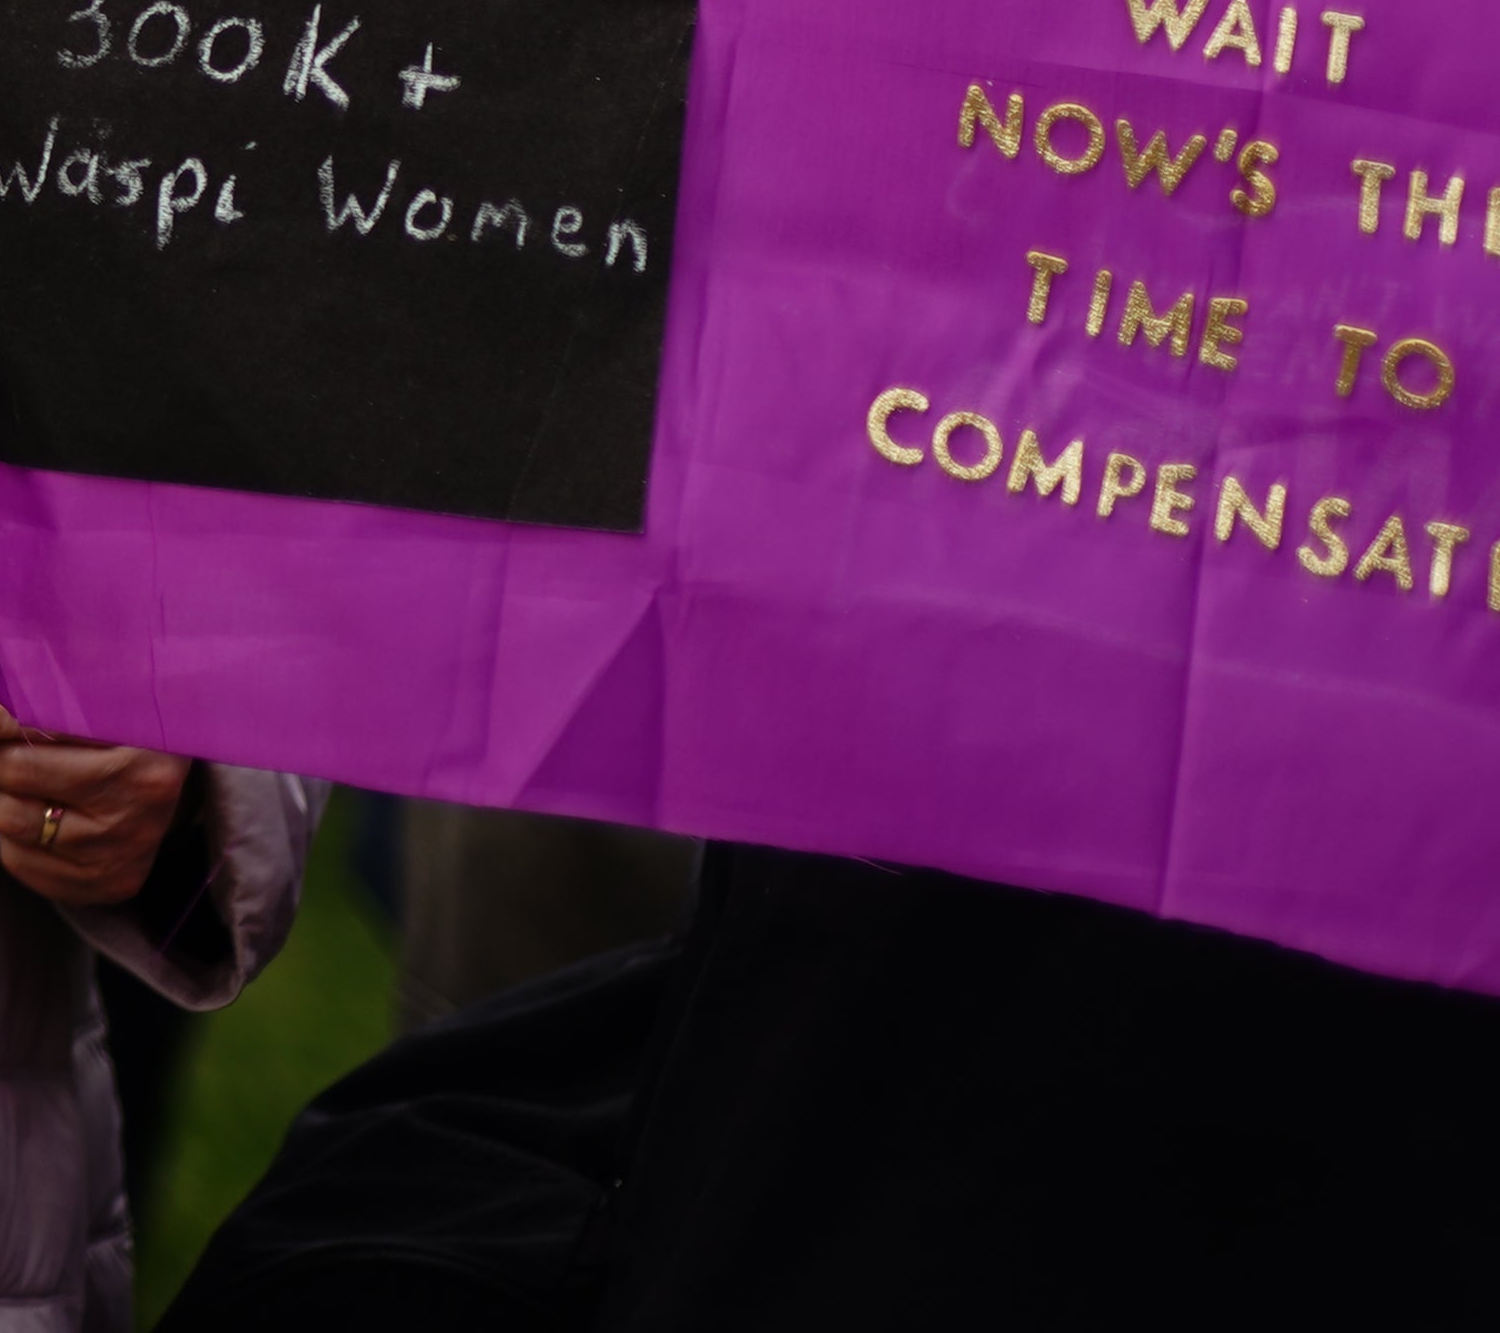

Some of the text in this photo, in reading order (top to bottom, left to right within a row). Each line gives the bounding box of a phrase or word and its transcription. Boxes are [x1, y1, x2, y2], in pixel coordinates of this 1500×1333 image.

[317, 157, 648, 274] Women
[956, 83, 1279, 217] NOW'S
[1024, 250, 1455, 410] TIME TO
[866, 386, 1500, 614] COMPENSAT
